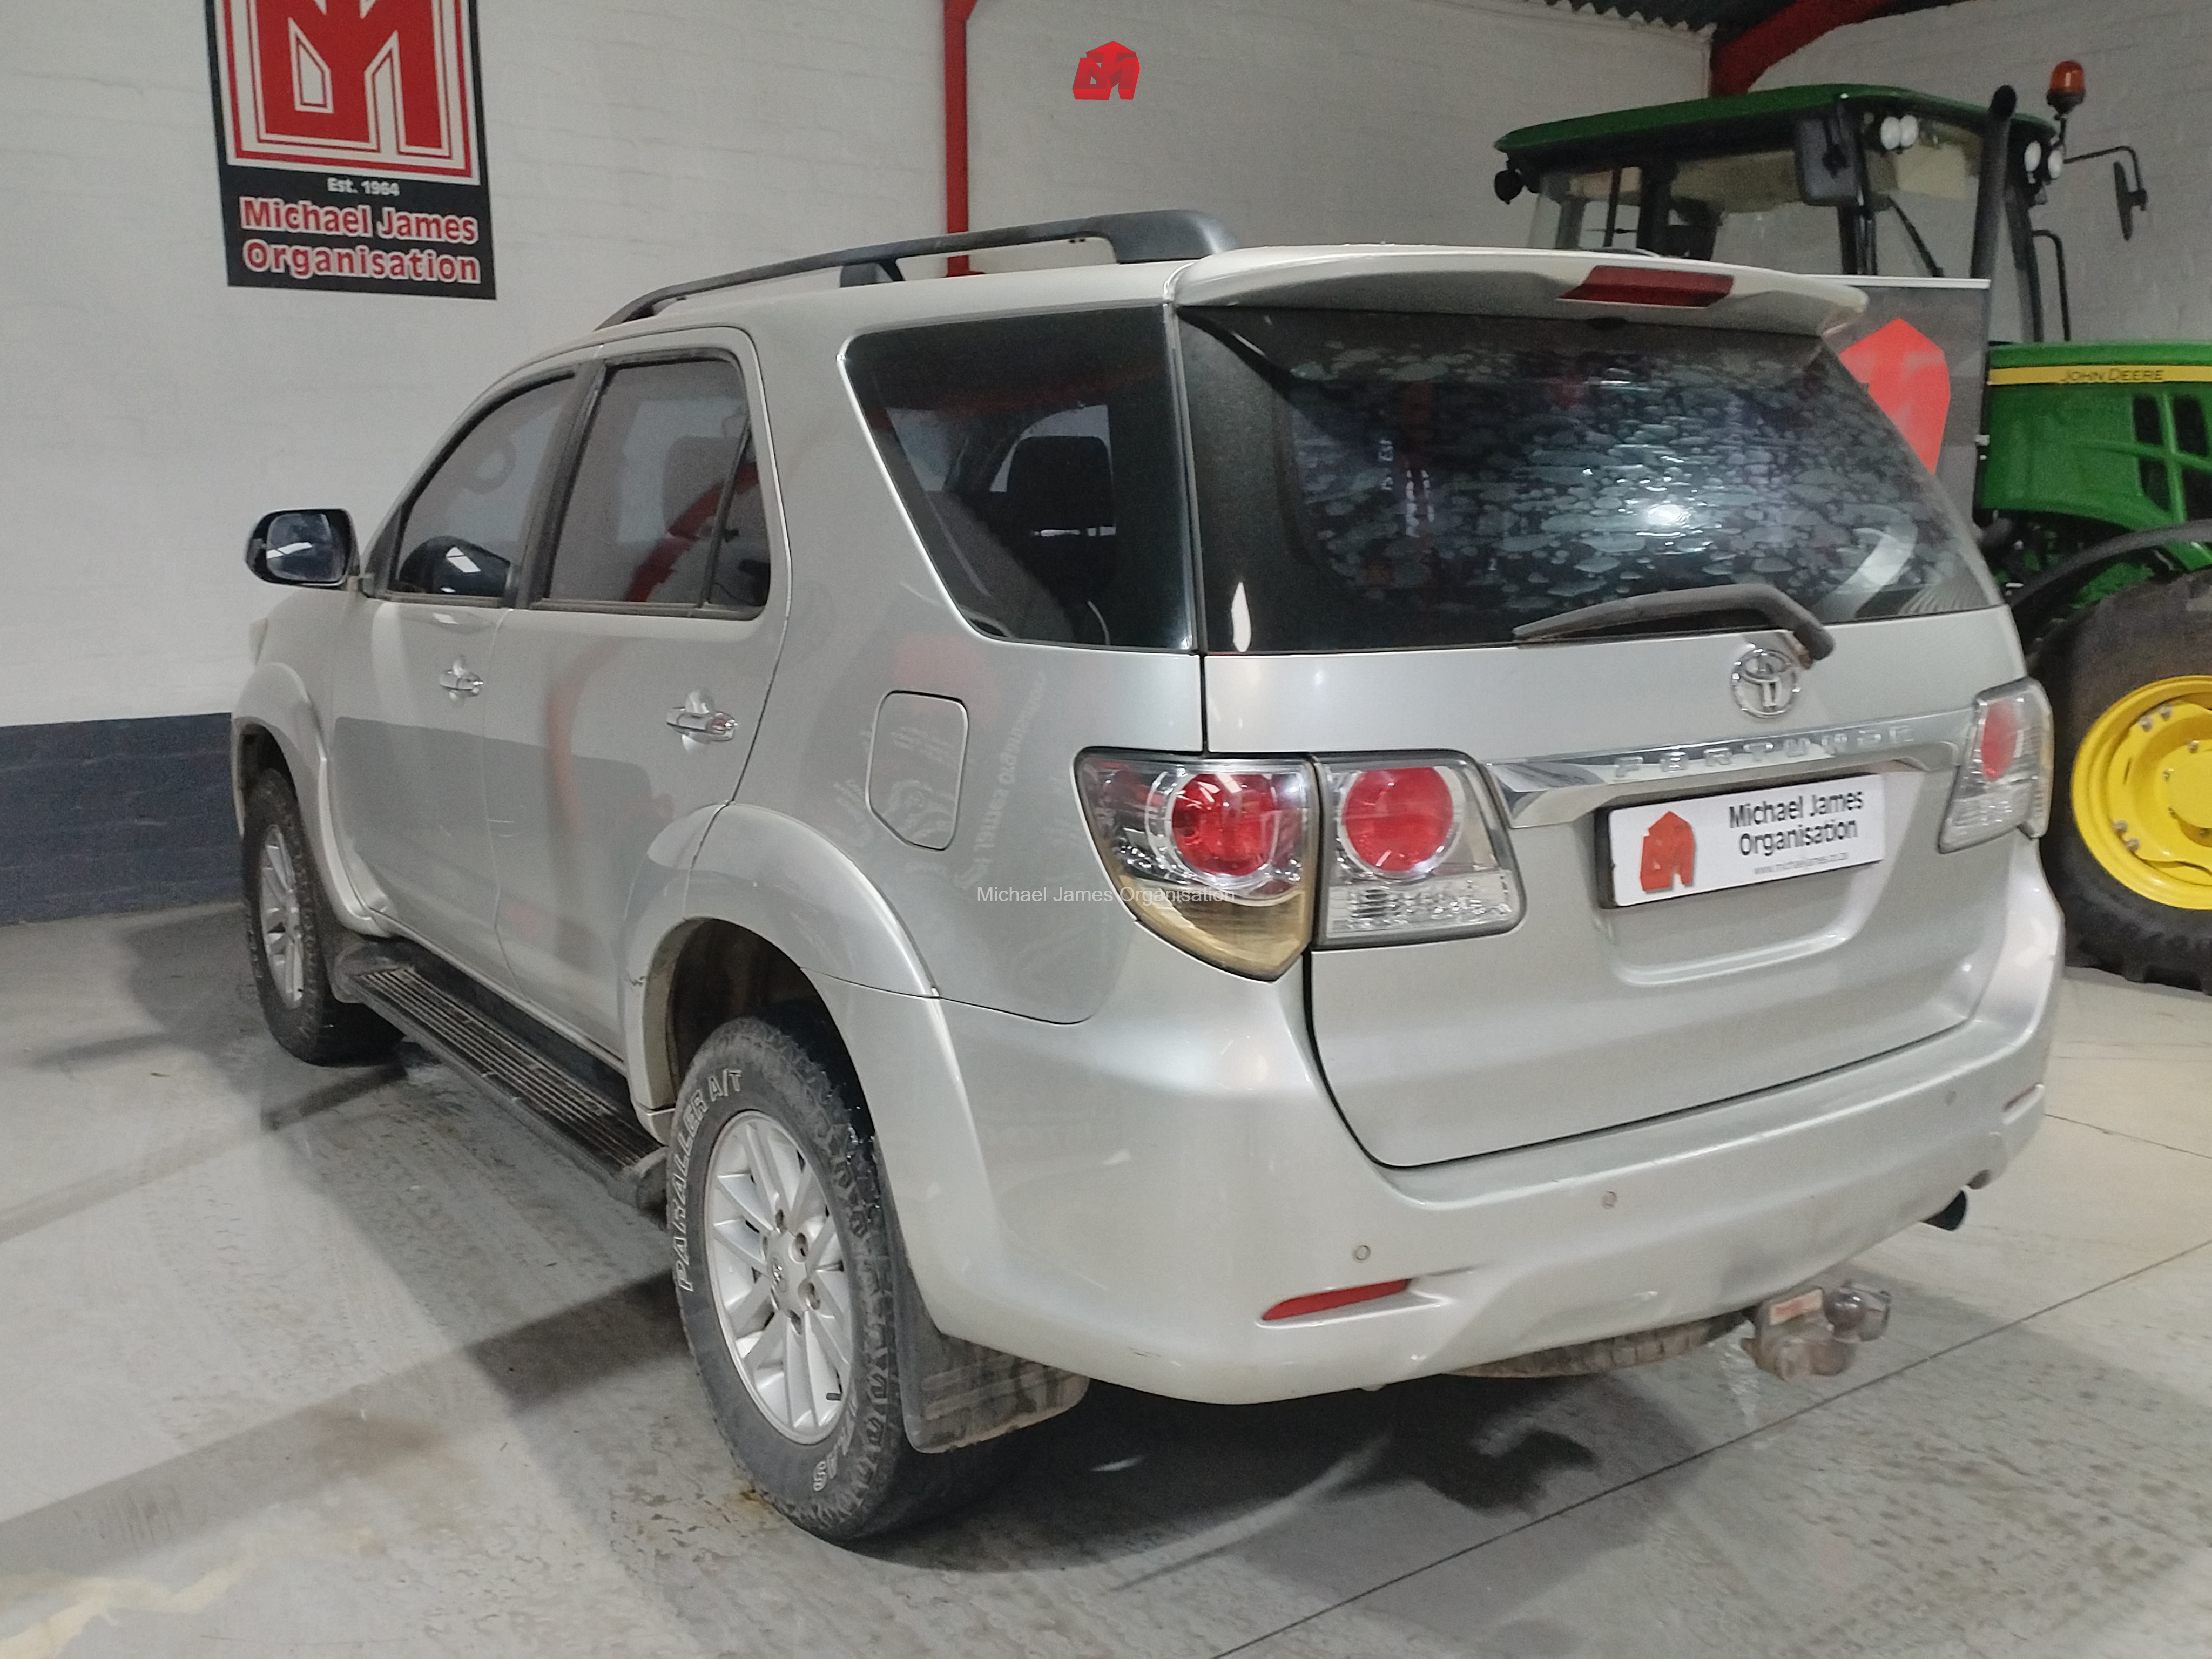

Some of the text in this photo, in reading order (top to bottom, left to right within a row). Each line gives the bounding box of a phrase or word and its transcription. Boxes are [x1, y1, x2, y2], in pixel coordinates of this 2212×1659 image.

[327, 177, 400, 197] Est. 1964
[239, 196, 479, 244] Michael James
[242, 239, 481, 284] Organisation
[2061, 368, 2163, 382] JOHN DEERE
[1729, 791, 1863, 828] Michael James
[1740, 819, 1858, 857] Organisation
[672, 1068, 743, 1292] PARALLER A/T
